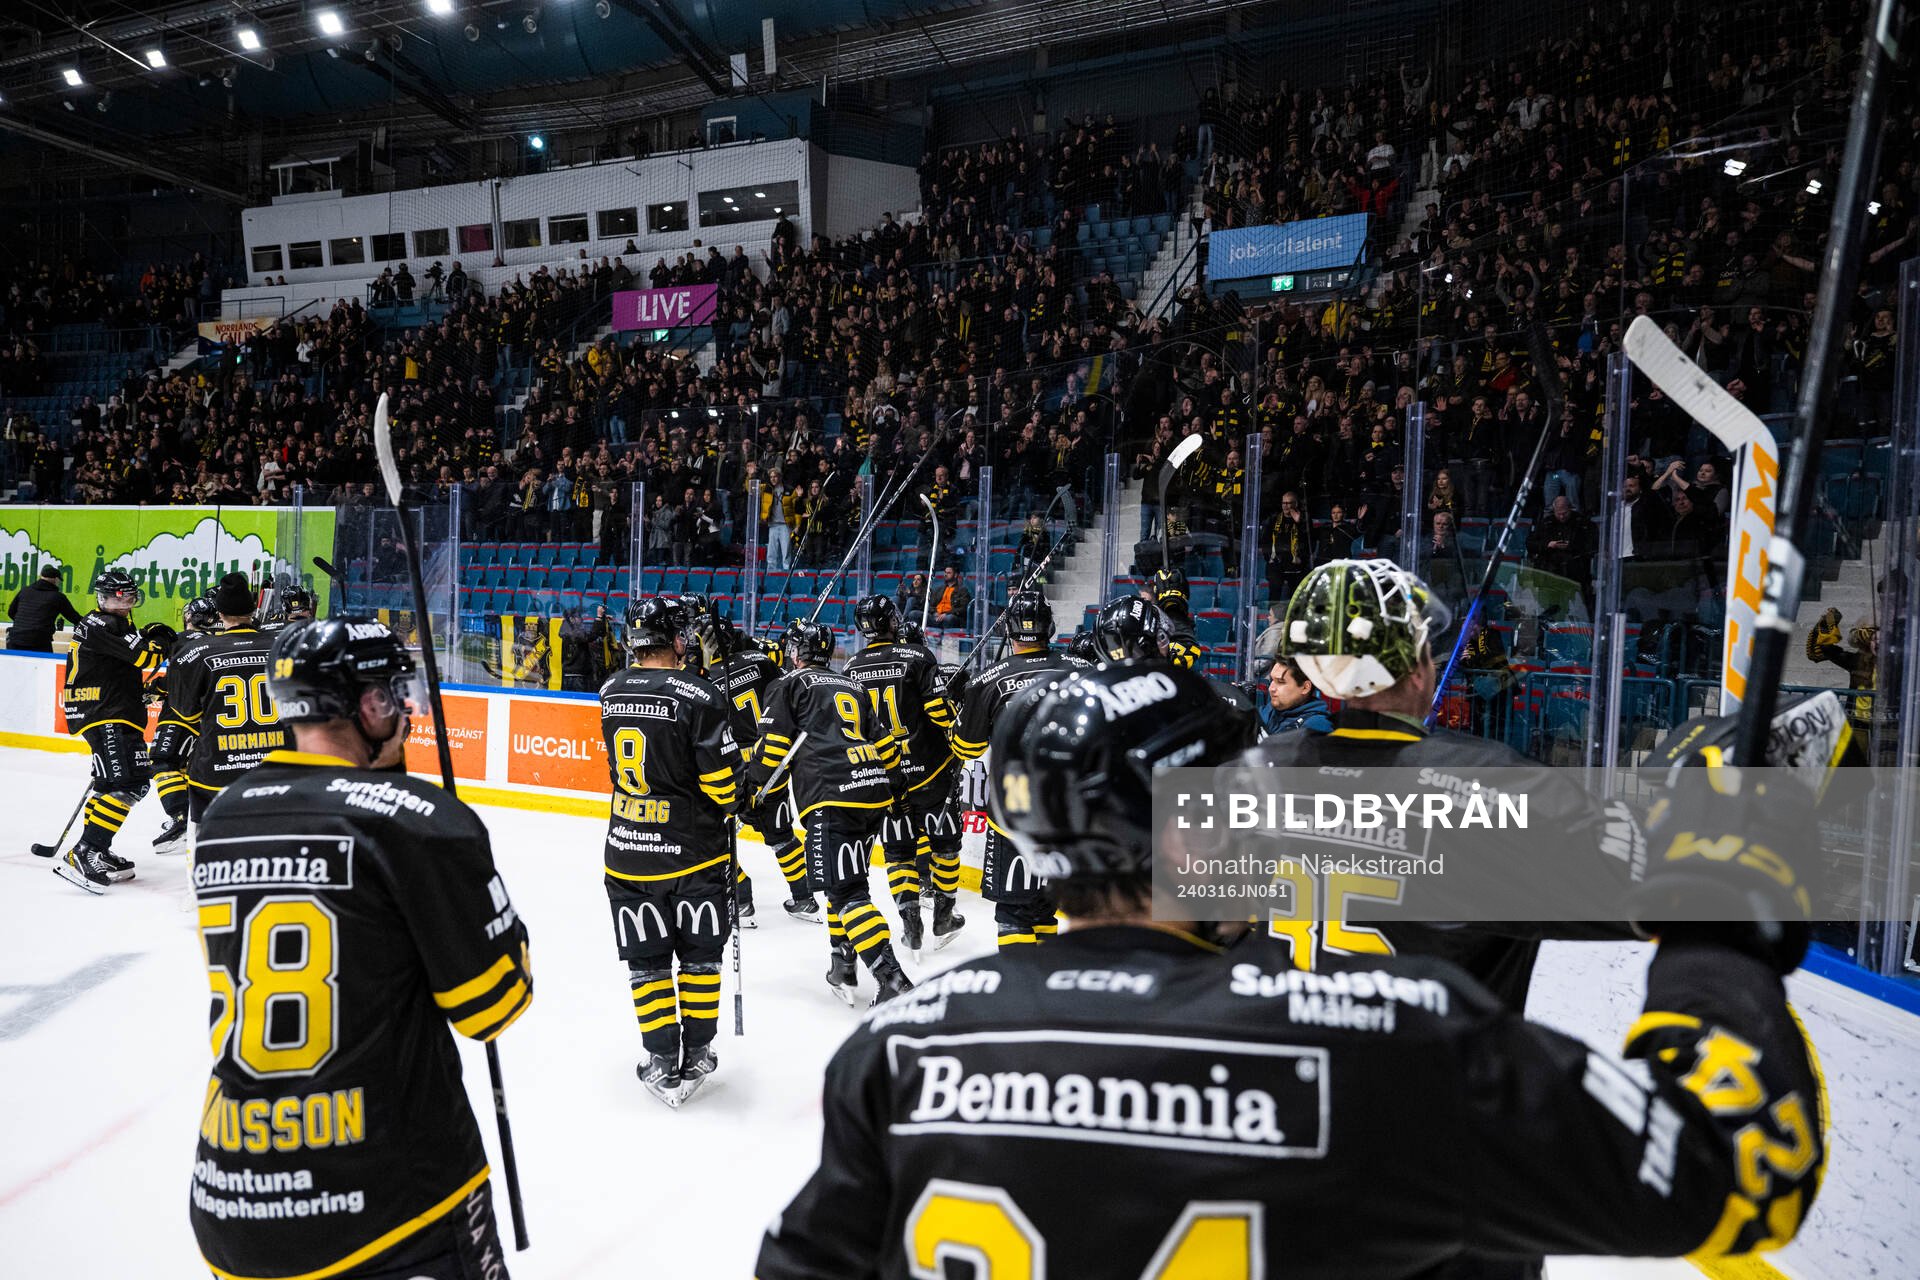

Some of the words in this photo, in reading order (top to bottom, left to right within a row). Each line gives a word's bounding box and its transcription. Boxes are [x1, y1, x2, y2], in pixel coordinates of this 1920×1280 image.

[641, 291, 690, 321] LIVE
[177, 644, 209, 664] Sundsten
[212, 653, 269, 669] Bemanni
[892, 647, 924, 658] Sundsten
[850, 666, 902, 681] Bemannia
[972, 662, 1009, 685] Sundsten
[215, 672, 281, 729] 30
[666, 677, 710, 701] Sundsten
[602, 701, 669, 717] Bemannia
[834, 692, 867, 741] 9
[217, 731, 285, 751] NORMANN
[613, 727, 651, 797] 8
[242, 785, 292, 799] CCM
[326, 778, 435, 818] Sundsten
[193, 846, 331, 888] emannia
[815, 822, 824, 883] JÄRFÄLLA
[986, 829, 995, 890] JÄRFÄLLA
[198, 894, 340, 1079] 58
[1046, 968, 1155, 995] CCM
[910, 1055, 1286, 1144] Bemannia
[194, 1158, 313, 1194] ollentuna
